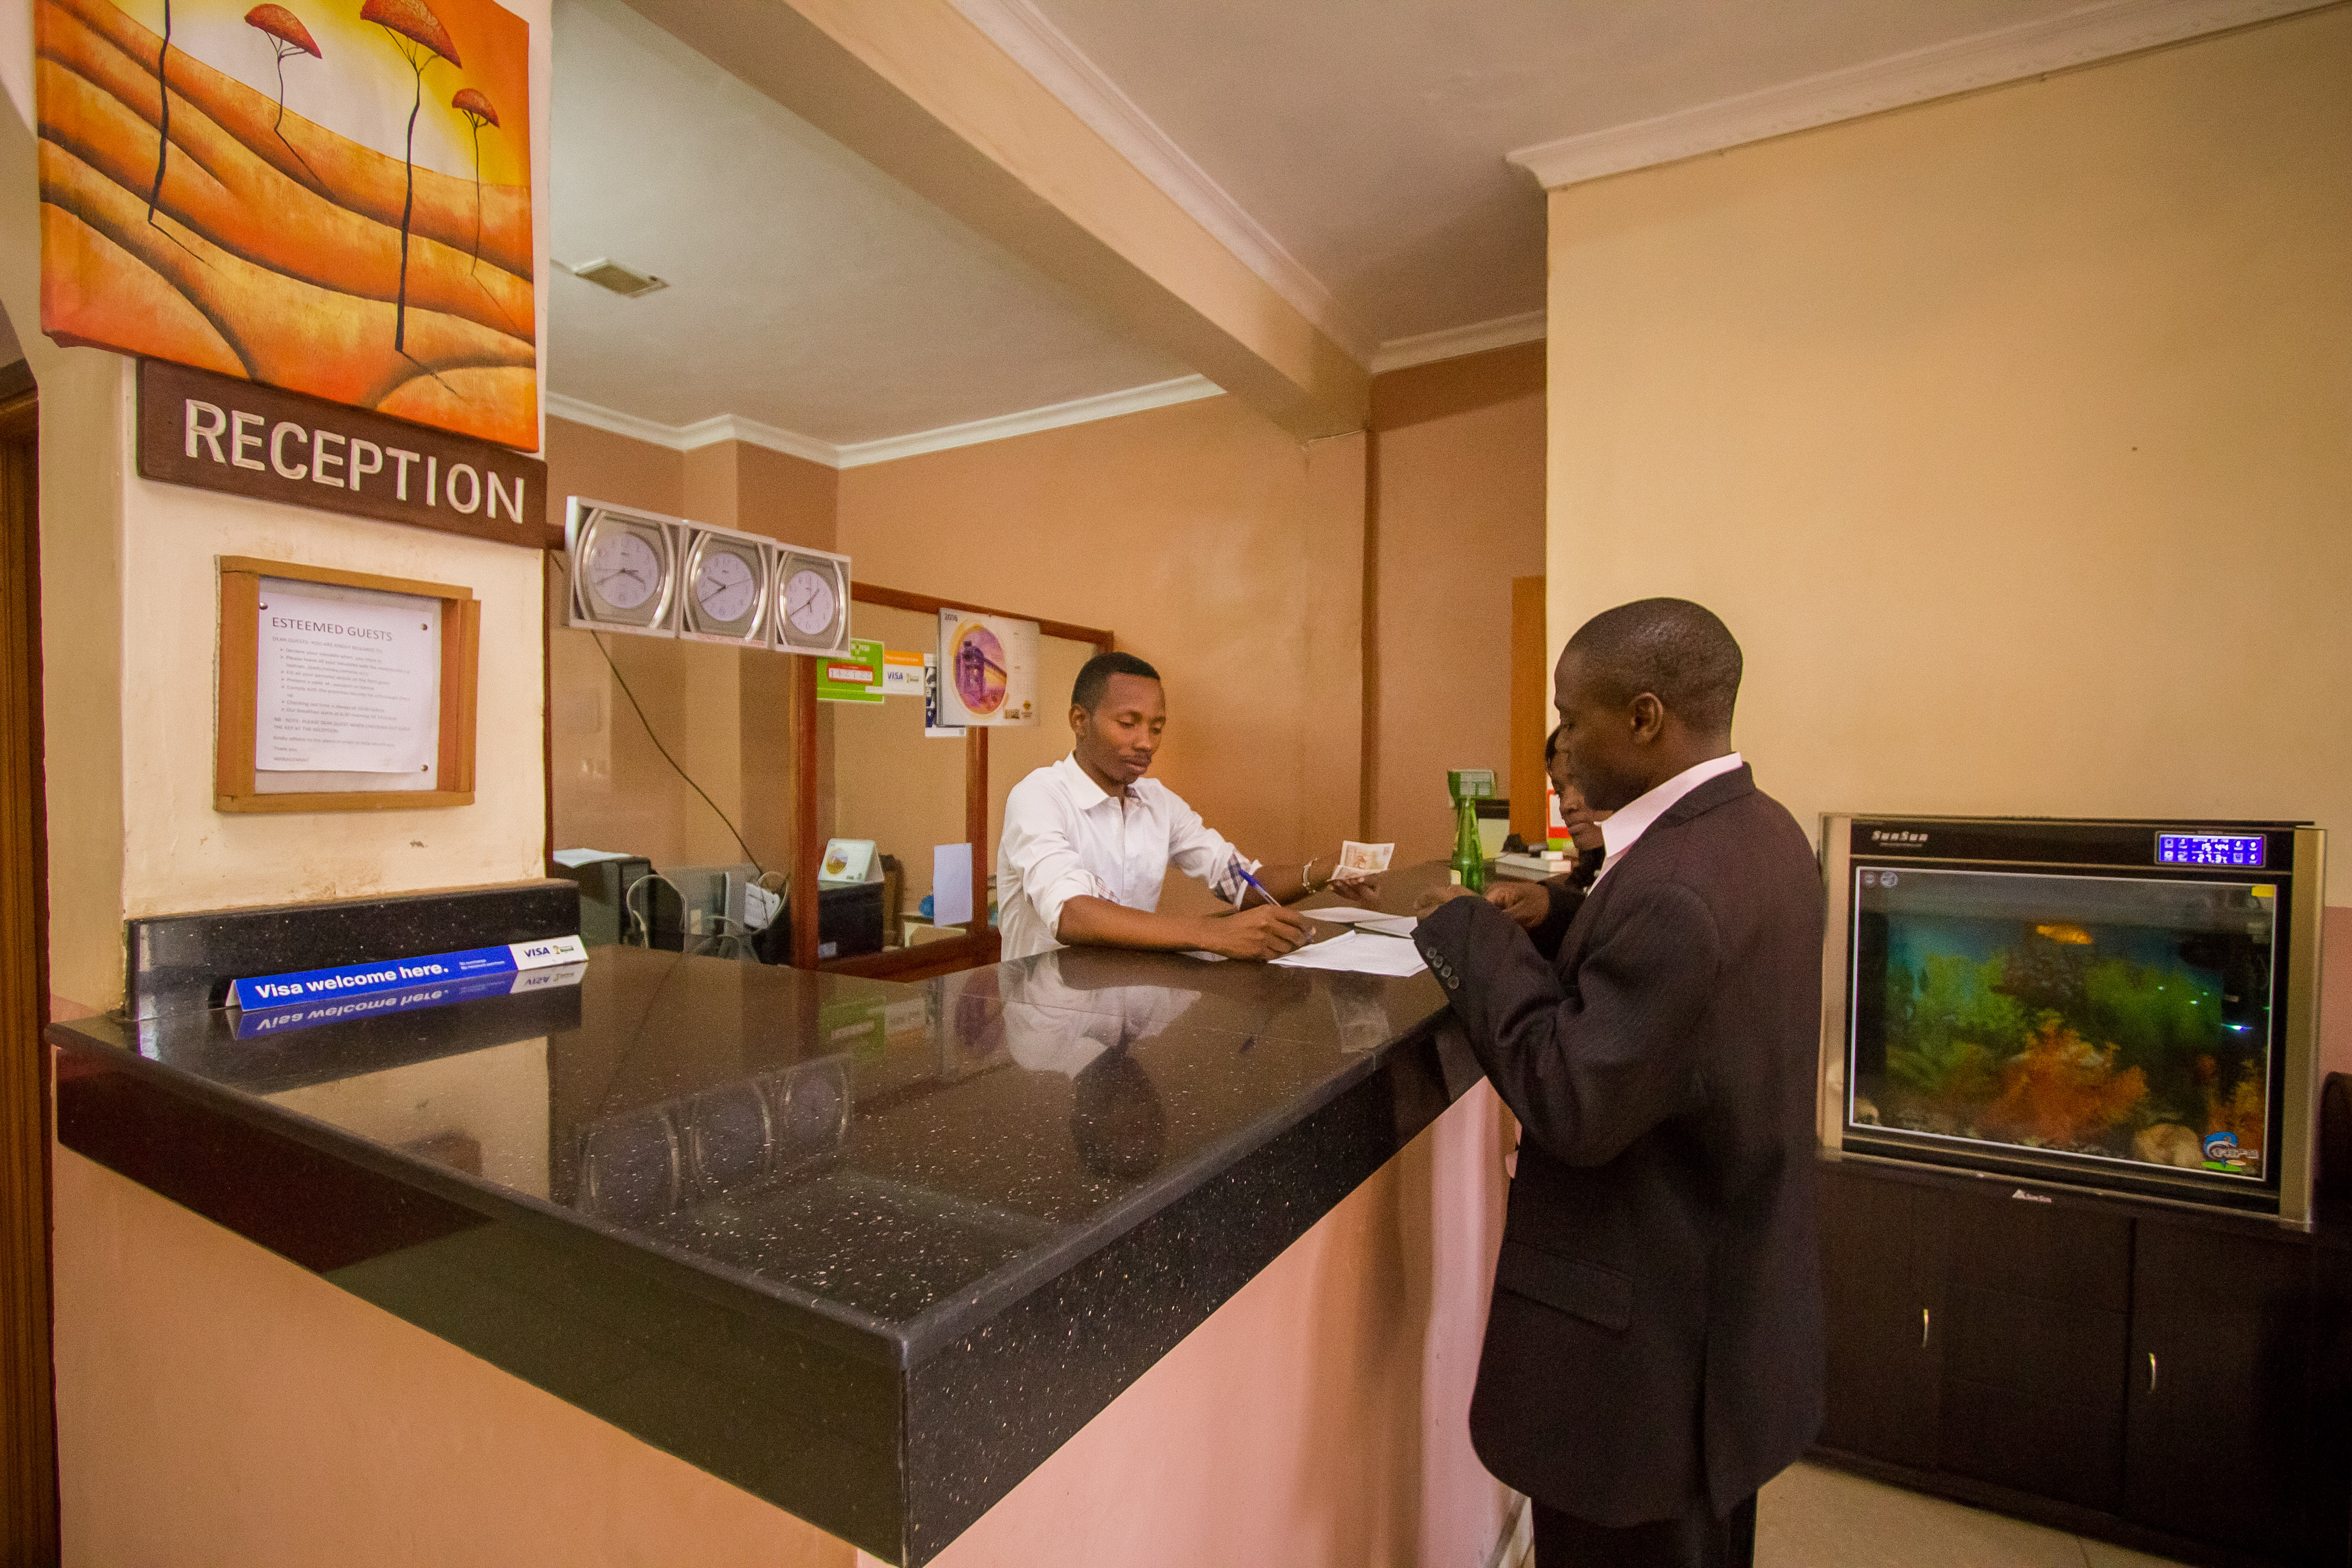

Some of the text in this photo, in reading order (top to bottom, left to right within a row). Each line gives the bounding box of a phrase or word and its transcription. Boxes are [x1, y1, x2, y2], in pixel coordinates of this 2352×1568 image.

[185, 399, 525, 525] RECEPTION
[272, 617, 393, 641] ESTEEMED GUESTS
[888, 672, 903, 680] VISA
[524, 946, 550, 957] VISA
[255, 983, 303, 999] Visa
[306, 969, 398, 992] welcome
[399, 963, 449, 979] here.
